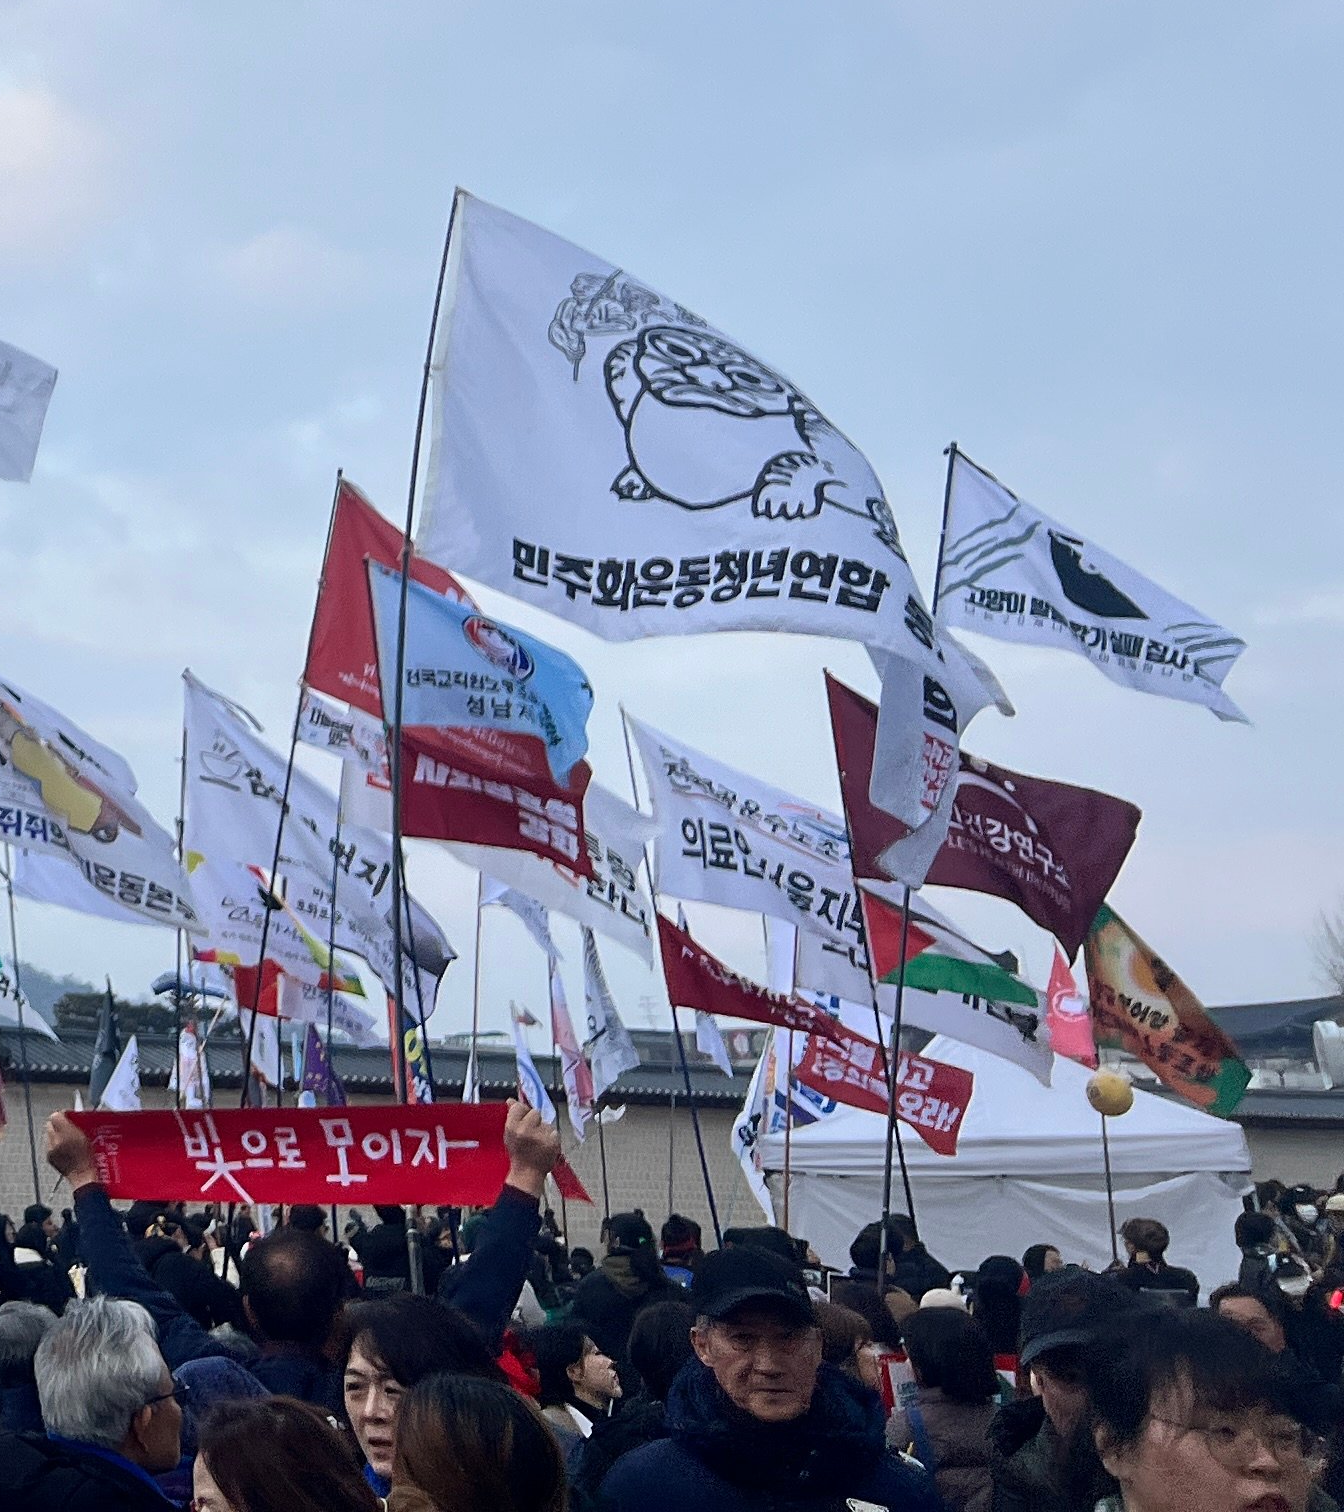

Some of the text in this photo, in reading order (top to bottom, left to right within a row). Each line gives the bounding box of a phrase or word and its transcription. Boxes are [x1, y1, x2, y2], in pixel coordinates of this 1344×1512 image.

[511, 537, 892, 615] 민주화운동청년연합
[173, 1107, 307, 1205] 빛으로
[318, 1117, 480, 1187] 모이자
